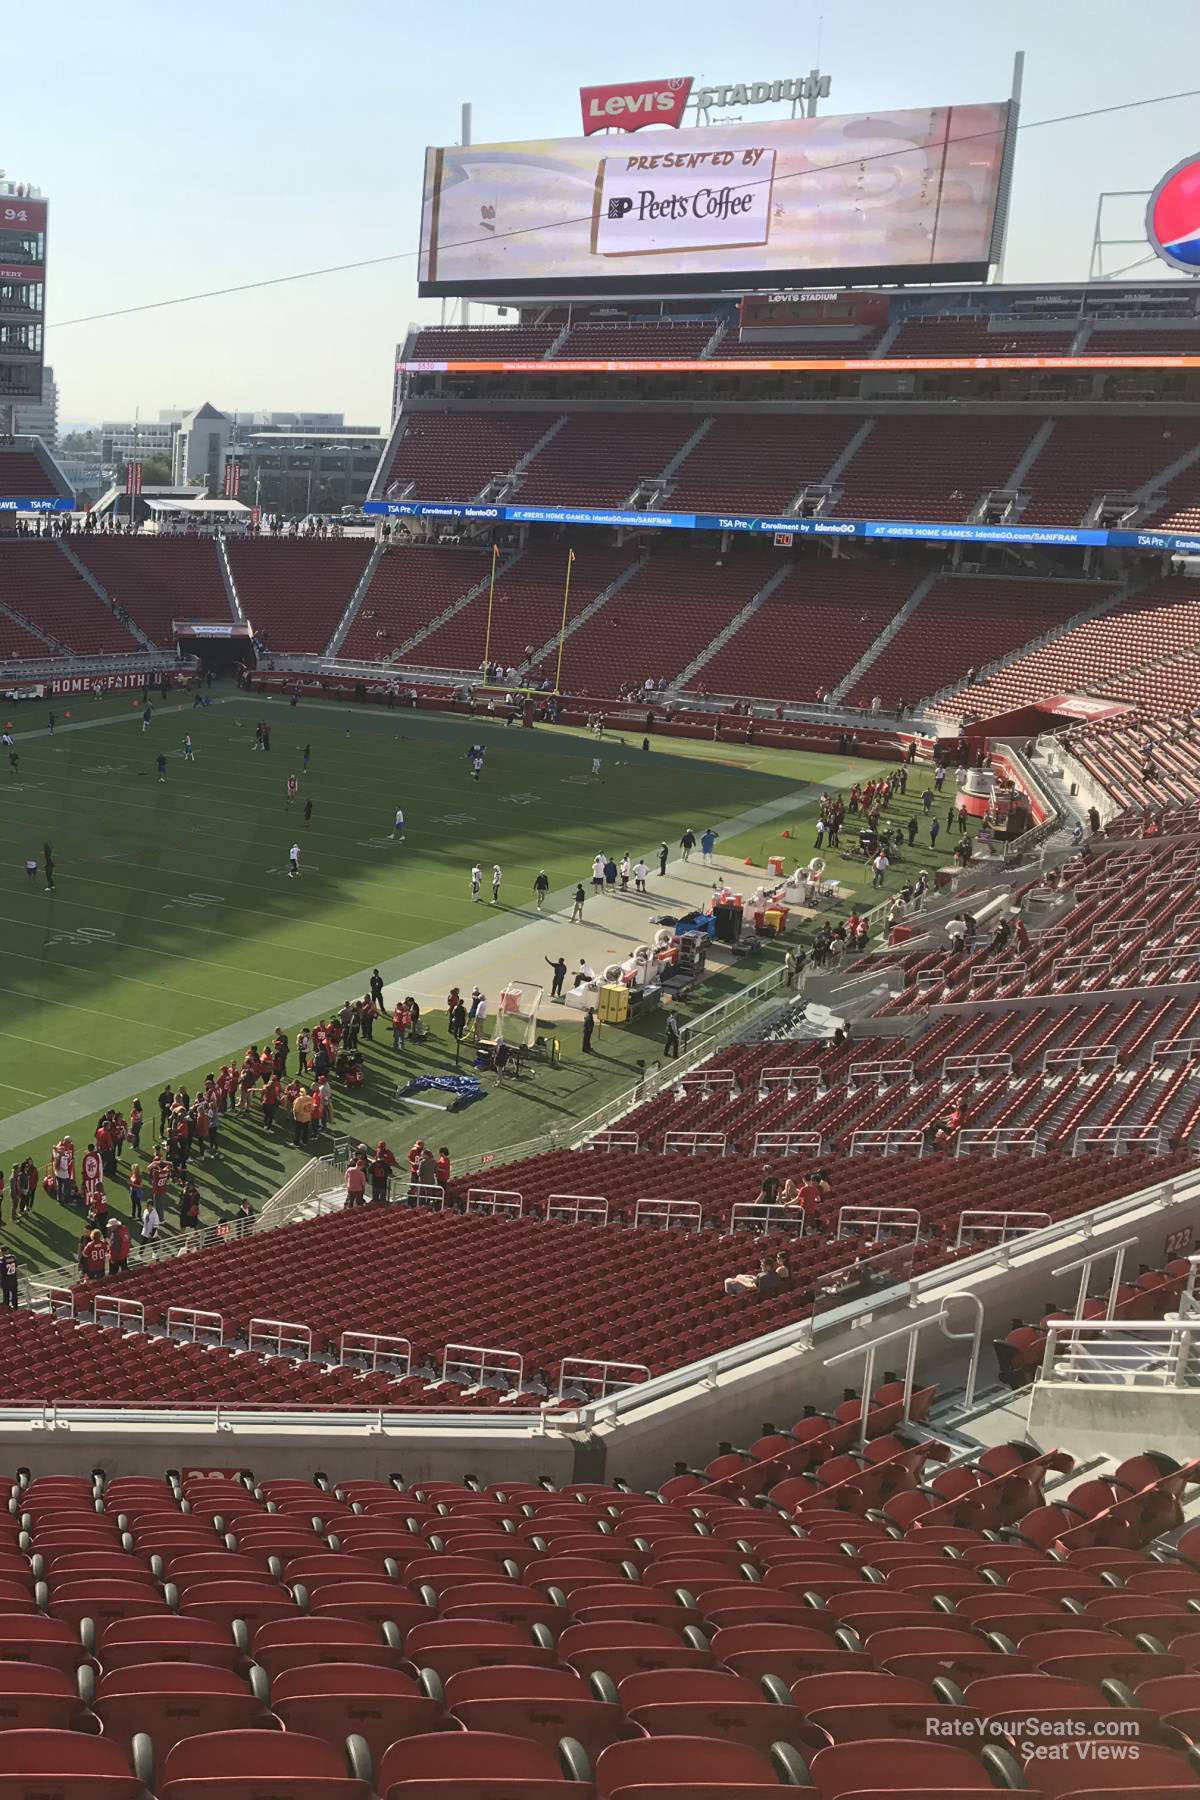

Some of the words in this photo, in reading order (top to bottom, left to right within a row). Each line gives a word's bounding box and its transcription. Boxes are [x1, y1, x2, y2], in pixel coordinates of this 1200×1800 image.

[696, 75, 832, 110] STADIUM
[626, 149, 734, 171] PRESENTED
[742, 147, 765, 167] BY
[638, 190, 688, 221] Peet's
[693, 186, 753, 220] Coffee
[5, 208, 28, 222] 94
[801, 293, 837, 301] STADIUM
[388, 505, 400, 513] TSA
[719, 519, 733, 528] TSA
[734, 520, 747, 529] Pre
[761, 522, 798, 531] Enrollment
[801, 523, 809, 533] by
[874, 526, 885, 535] AT
[887, 527, 914, 536] 49ERS
[915, 529, 940, 537] HOME
[776, 534, 791, 544] 40
[1137, 535, 1150, 545] TSA
[52, 677, 91, 693] HOME
